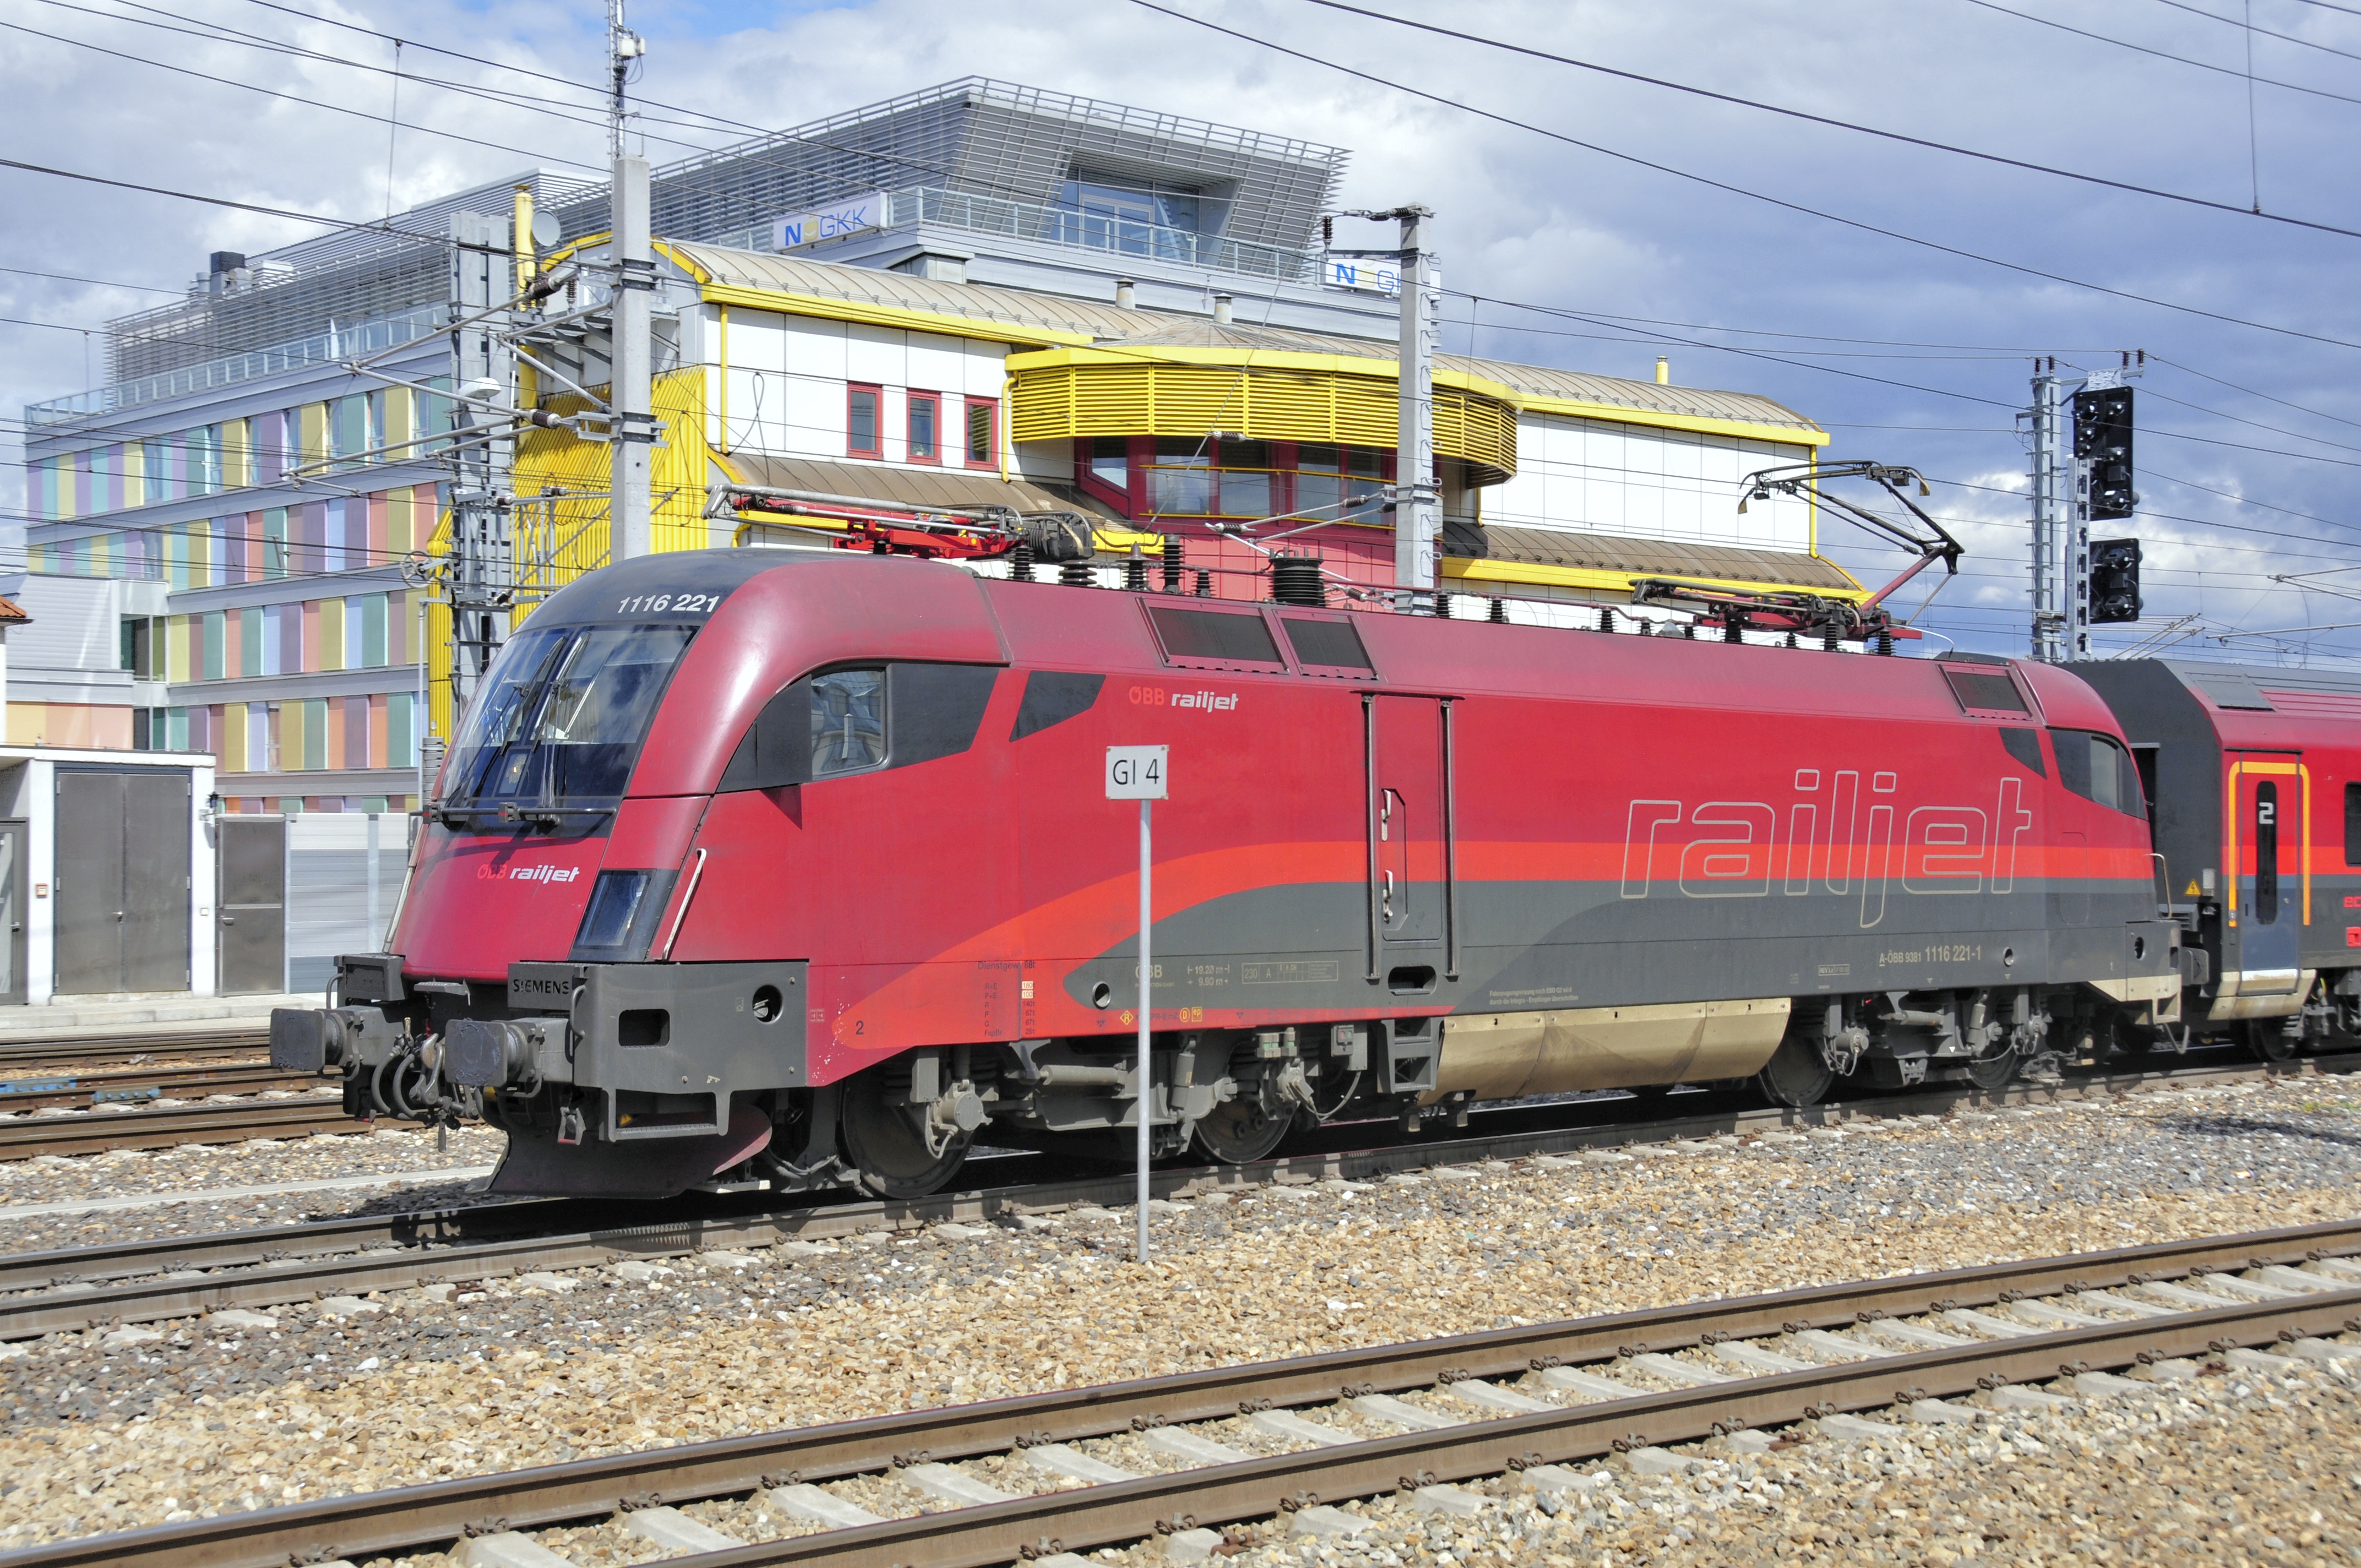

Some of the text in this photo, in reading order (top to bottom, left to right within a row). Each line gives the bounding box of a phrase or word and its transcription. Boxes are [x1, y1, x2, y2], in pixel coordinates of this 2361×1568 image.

[618, 594, 720, 613] 1116 221
[1171, 690, 1238, 713] railjet
[1146, 759, 1159, 784] 4
[2259, 802, 2274, 824] 2
[1620, 769, 2032, 928] railjet
[509, 864, 580, 884] railjet
[1905, 952, 1921, 962] 9381
[1925, 945, 1950, 962] 1116
[1952, 945, 1981, 961] 221-1
[513, 979, 569, 994] SIEMENS
[856, 1020, 864, 1035] 2
